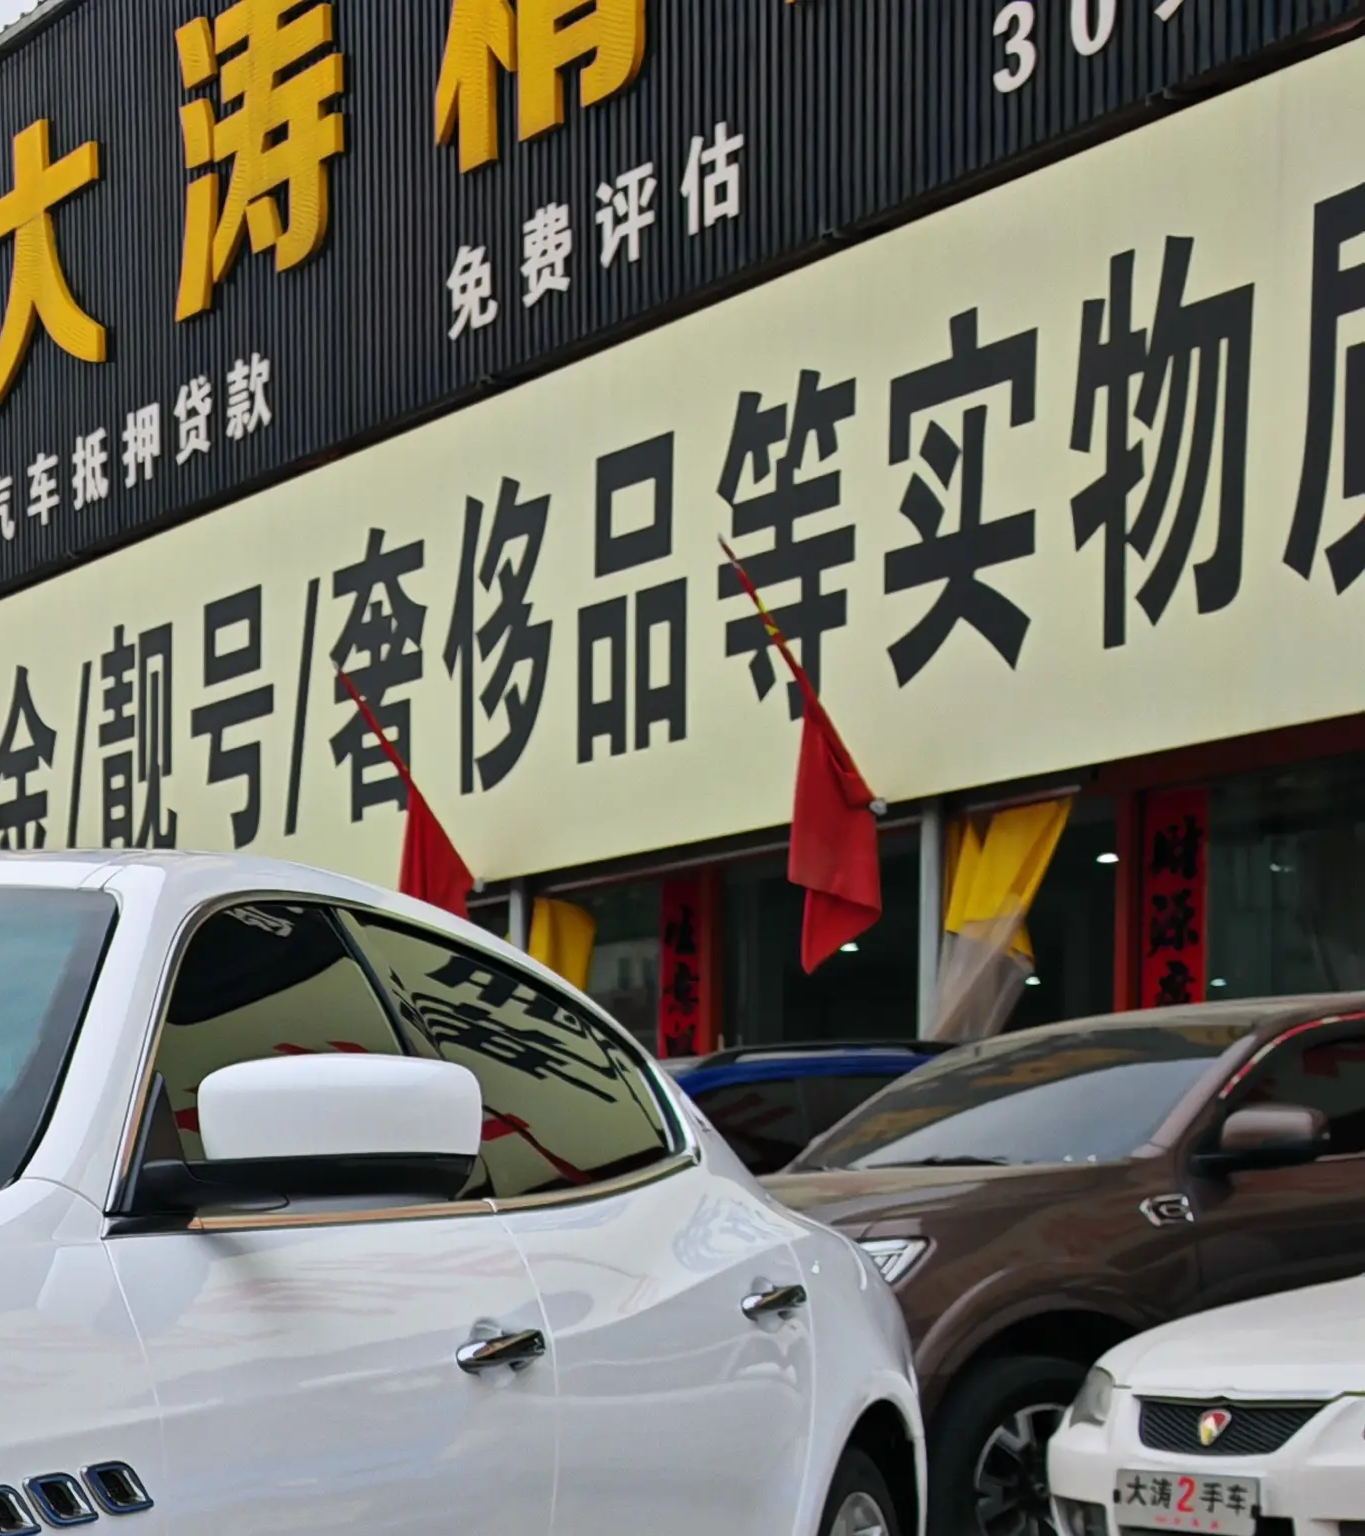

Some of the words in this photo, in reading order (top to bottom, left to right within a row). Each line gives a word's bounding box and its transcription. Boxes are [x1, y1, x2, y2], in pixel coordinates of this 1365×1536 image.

[446, 121, 745, 342] 免费评估
[992, 0, 1184, 93] 30
[1126, 1474, 1249, 1516] 大涛2手车
